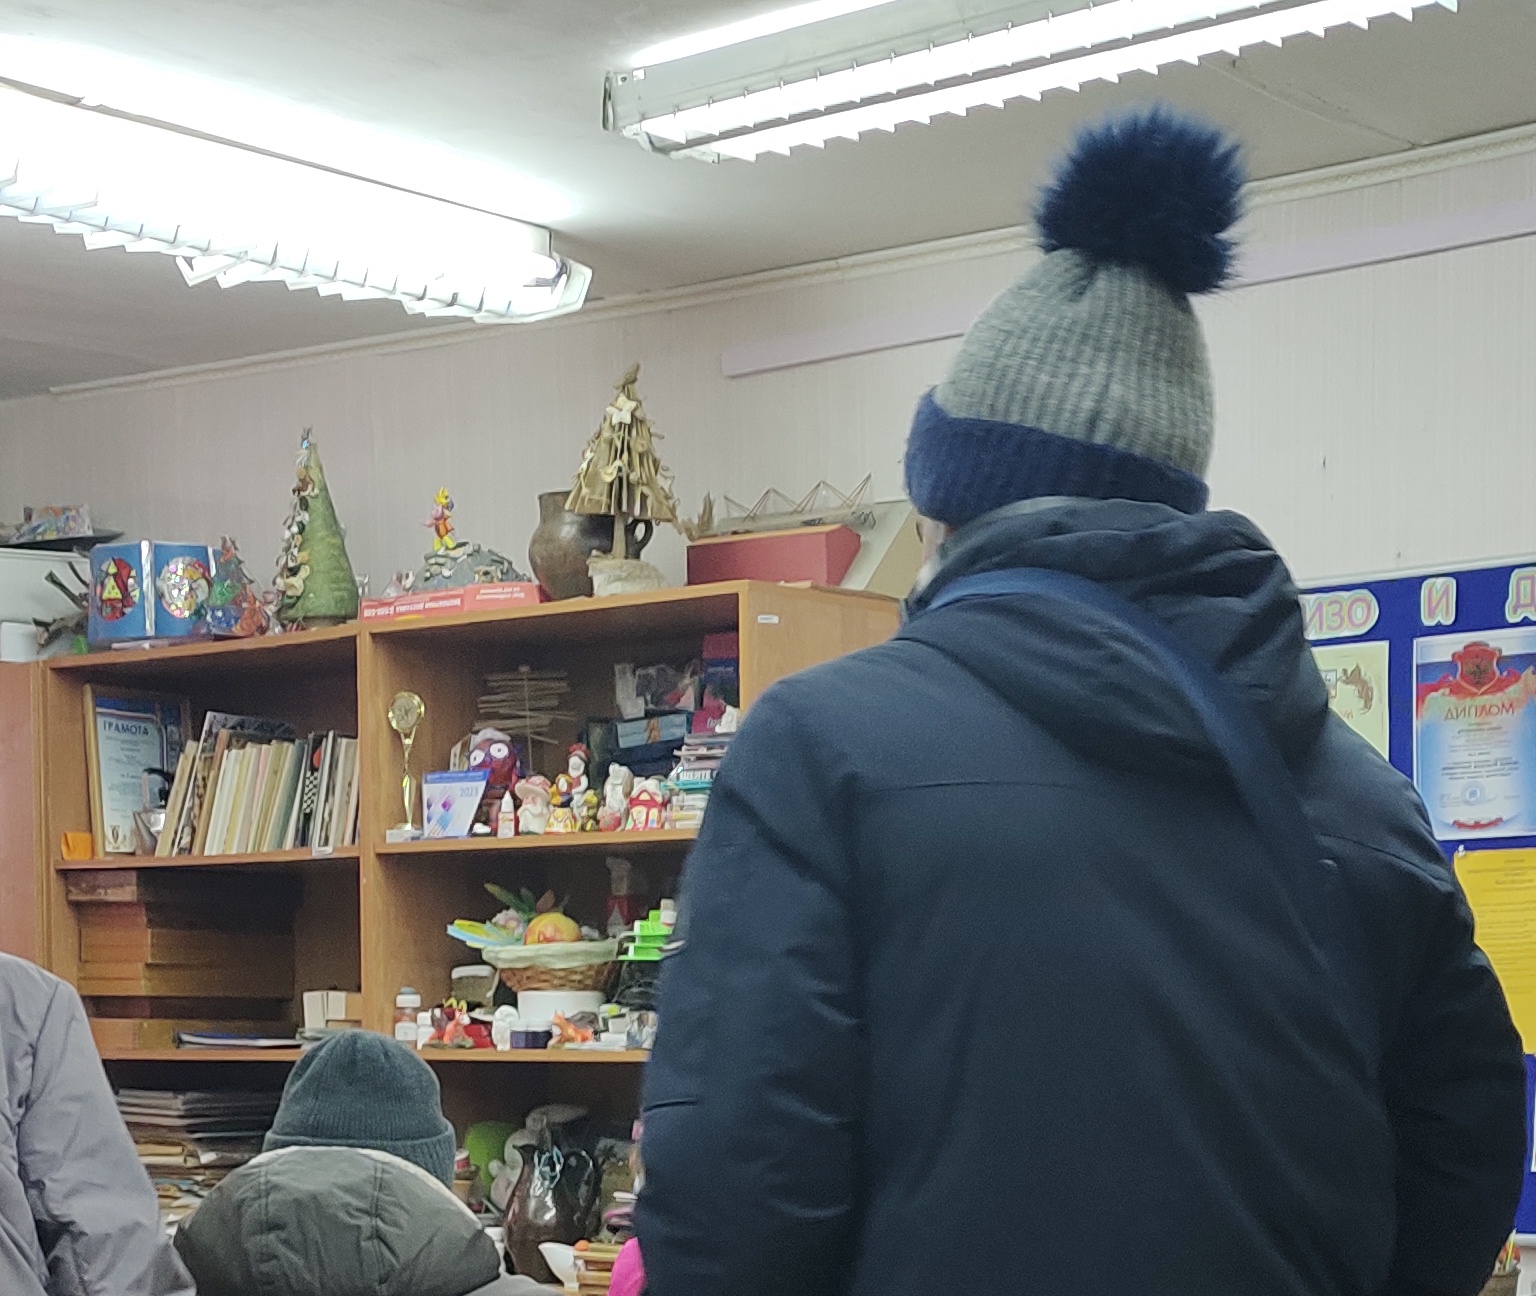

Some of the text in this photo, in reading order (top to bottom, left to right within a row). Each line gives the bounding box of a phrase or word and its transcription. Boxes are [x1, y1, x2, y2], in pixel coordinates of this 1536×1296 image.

[1425, 580, 1453, 622] И
[1444, 702, 1515, 721] ДИПЛОМ
[103, 719, 149, 735] ГРАМОТА
